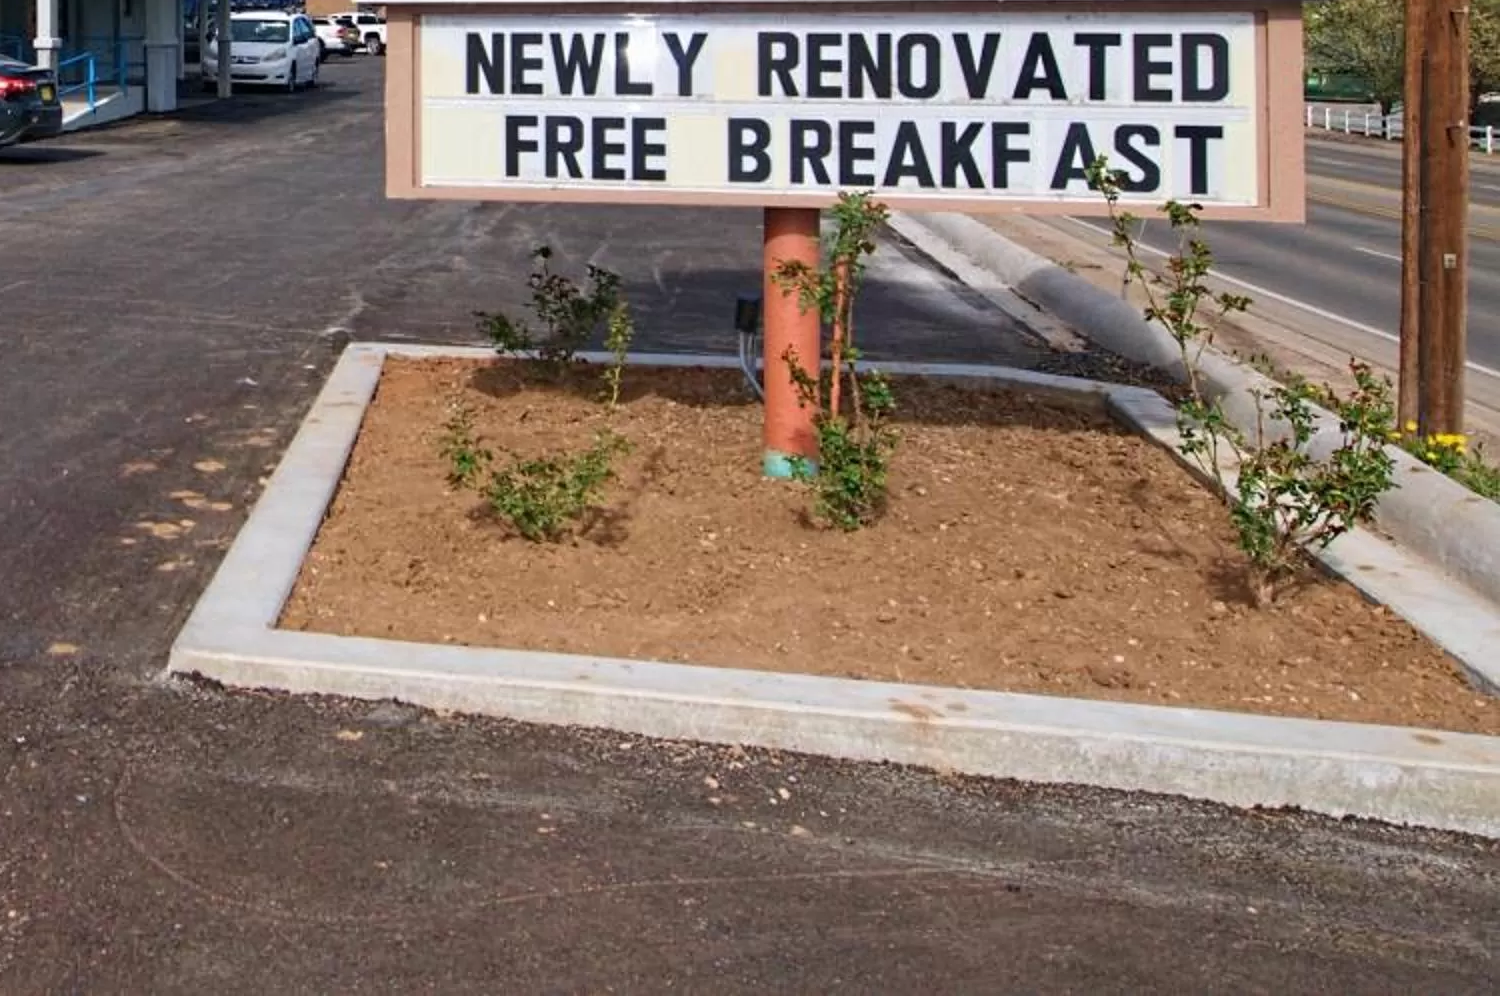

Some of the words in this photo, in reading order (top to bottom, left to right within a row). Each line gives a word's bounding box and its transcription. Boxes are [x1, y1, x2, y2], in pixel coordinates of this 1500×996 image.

[465, 31, 707, 96] NEWLY
[757, 32, 1230, 101] RENOVATED
[505, 114, 667, 182] FREE
[729, 119, 1224, 194] BREAKFAST
